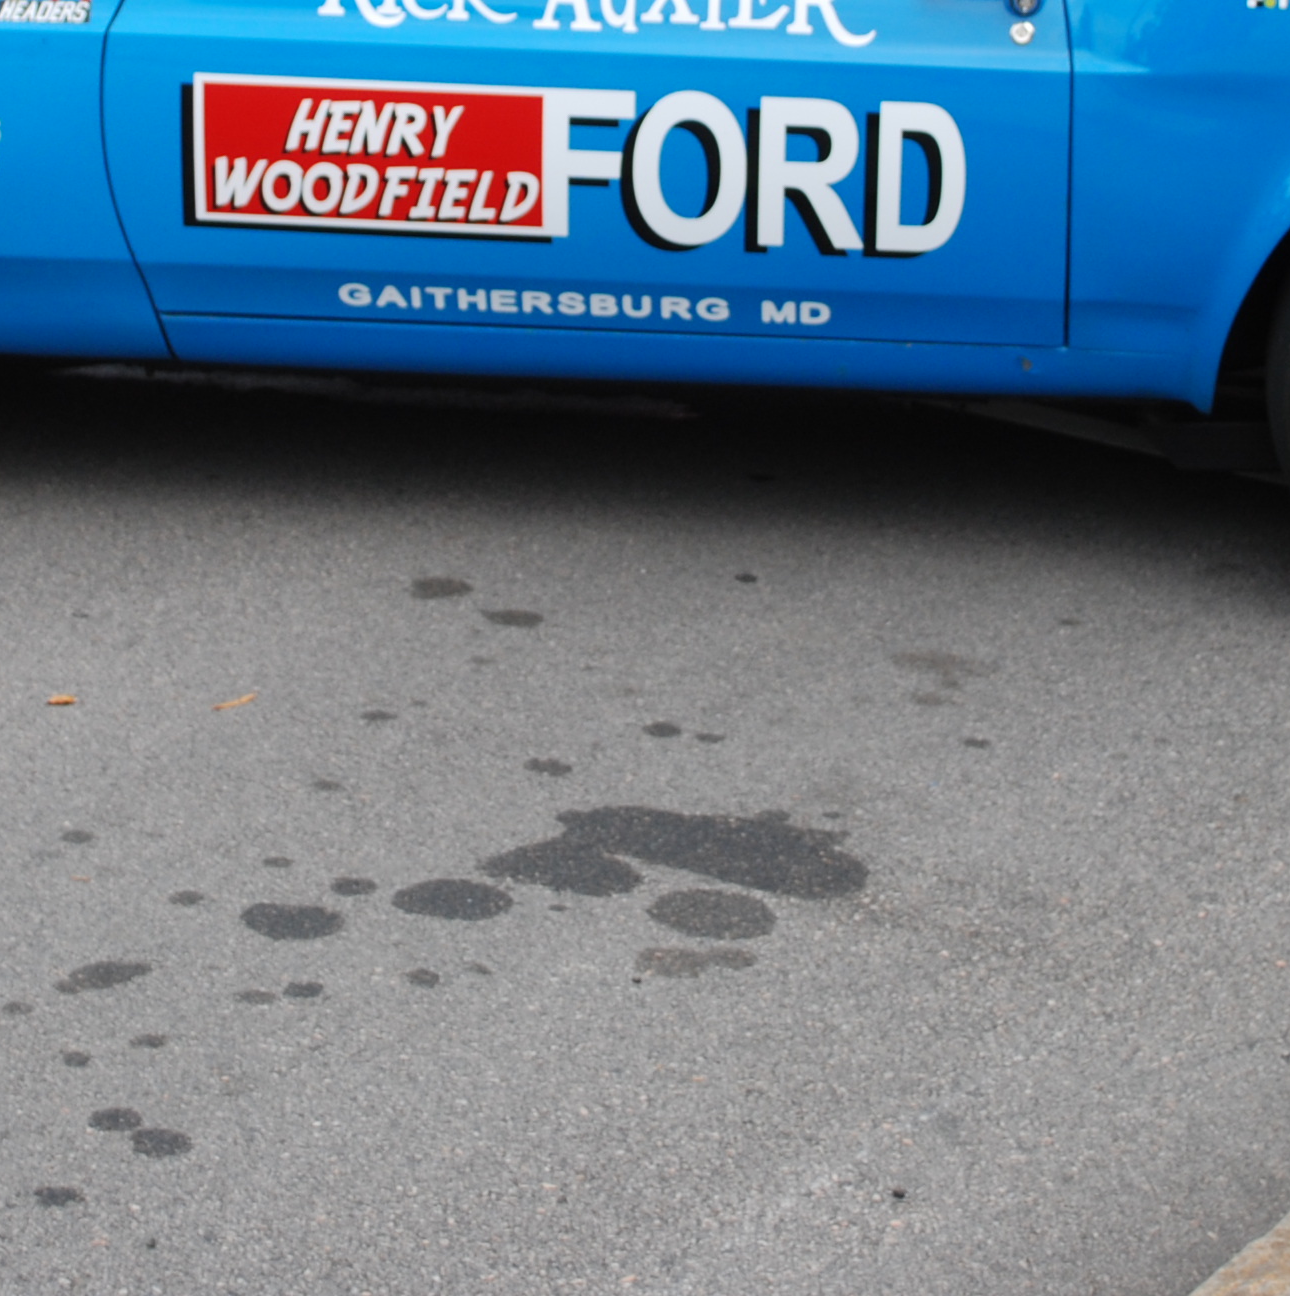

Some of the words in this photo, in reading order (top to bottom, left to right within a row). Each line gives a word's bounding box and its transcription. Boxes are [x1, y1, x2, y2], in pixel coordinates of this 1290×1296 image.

[282, 97, 465, 160] HENRY
[212, 155, 541, 223] WOODFIELD
[543, 86, 968, 256] FORD
[337, 281, 731, 322] GAITHERSBURG
[760, 299, 832, 326] MD
